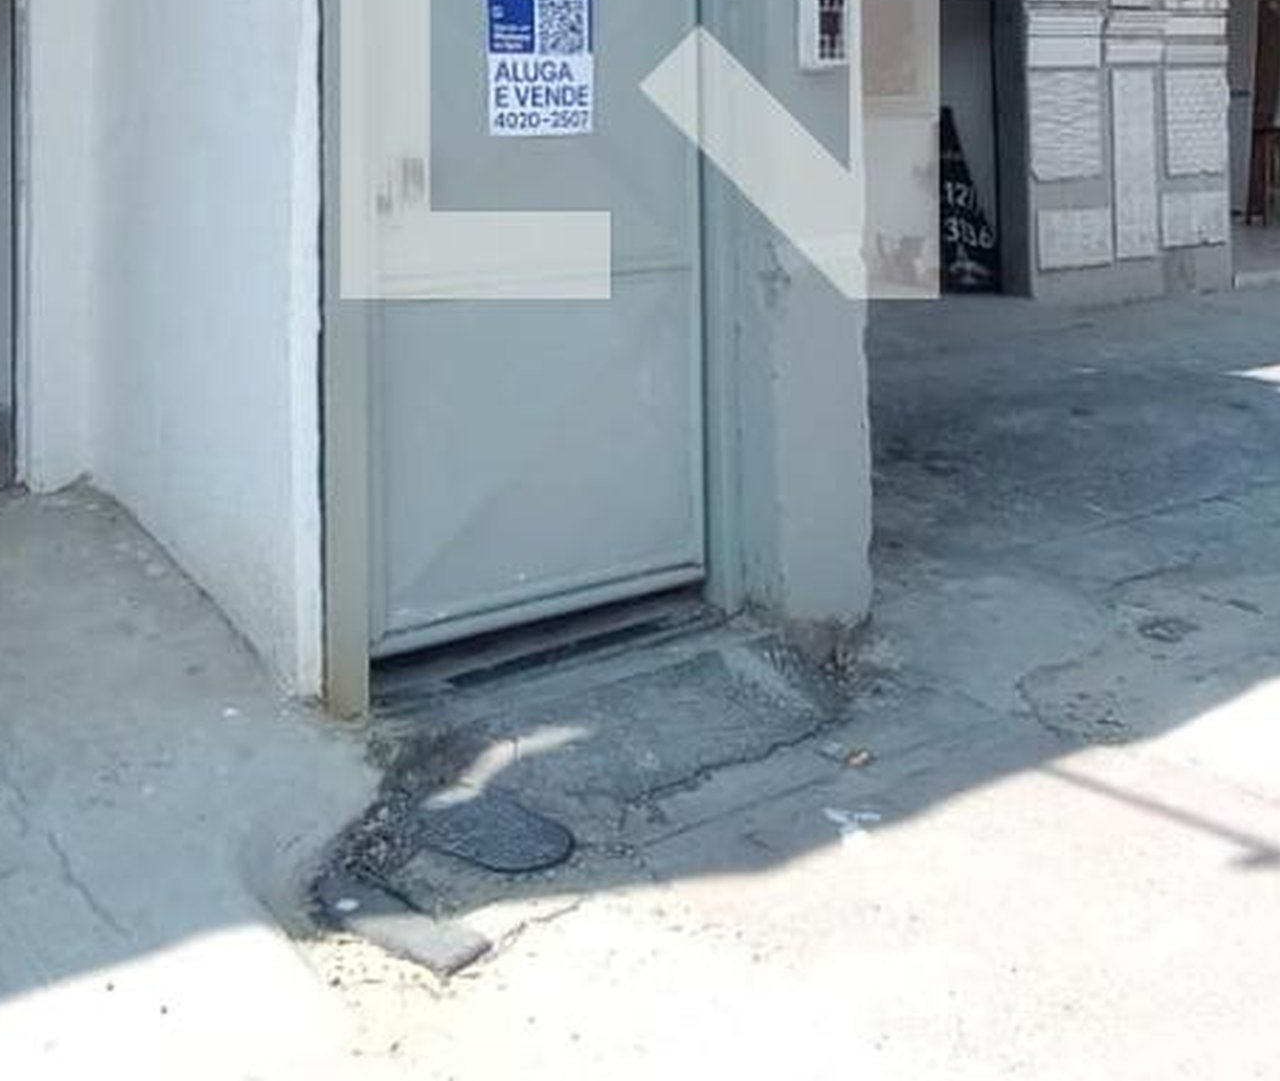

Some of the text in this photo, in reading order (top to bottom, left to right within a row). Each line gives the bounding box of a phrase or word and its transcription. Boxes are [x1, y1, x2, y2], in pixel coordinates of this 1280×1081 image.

[494, 60, 574, 82] ALUGA
[495, 85, 589, 108] E VENDE
